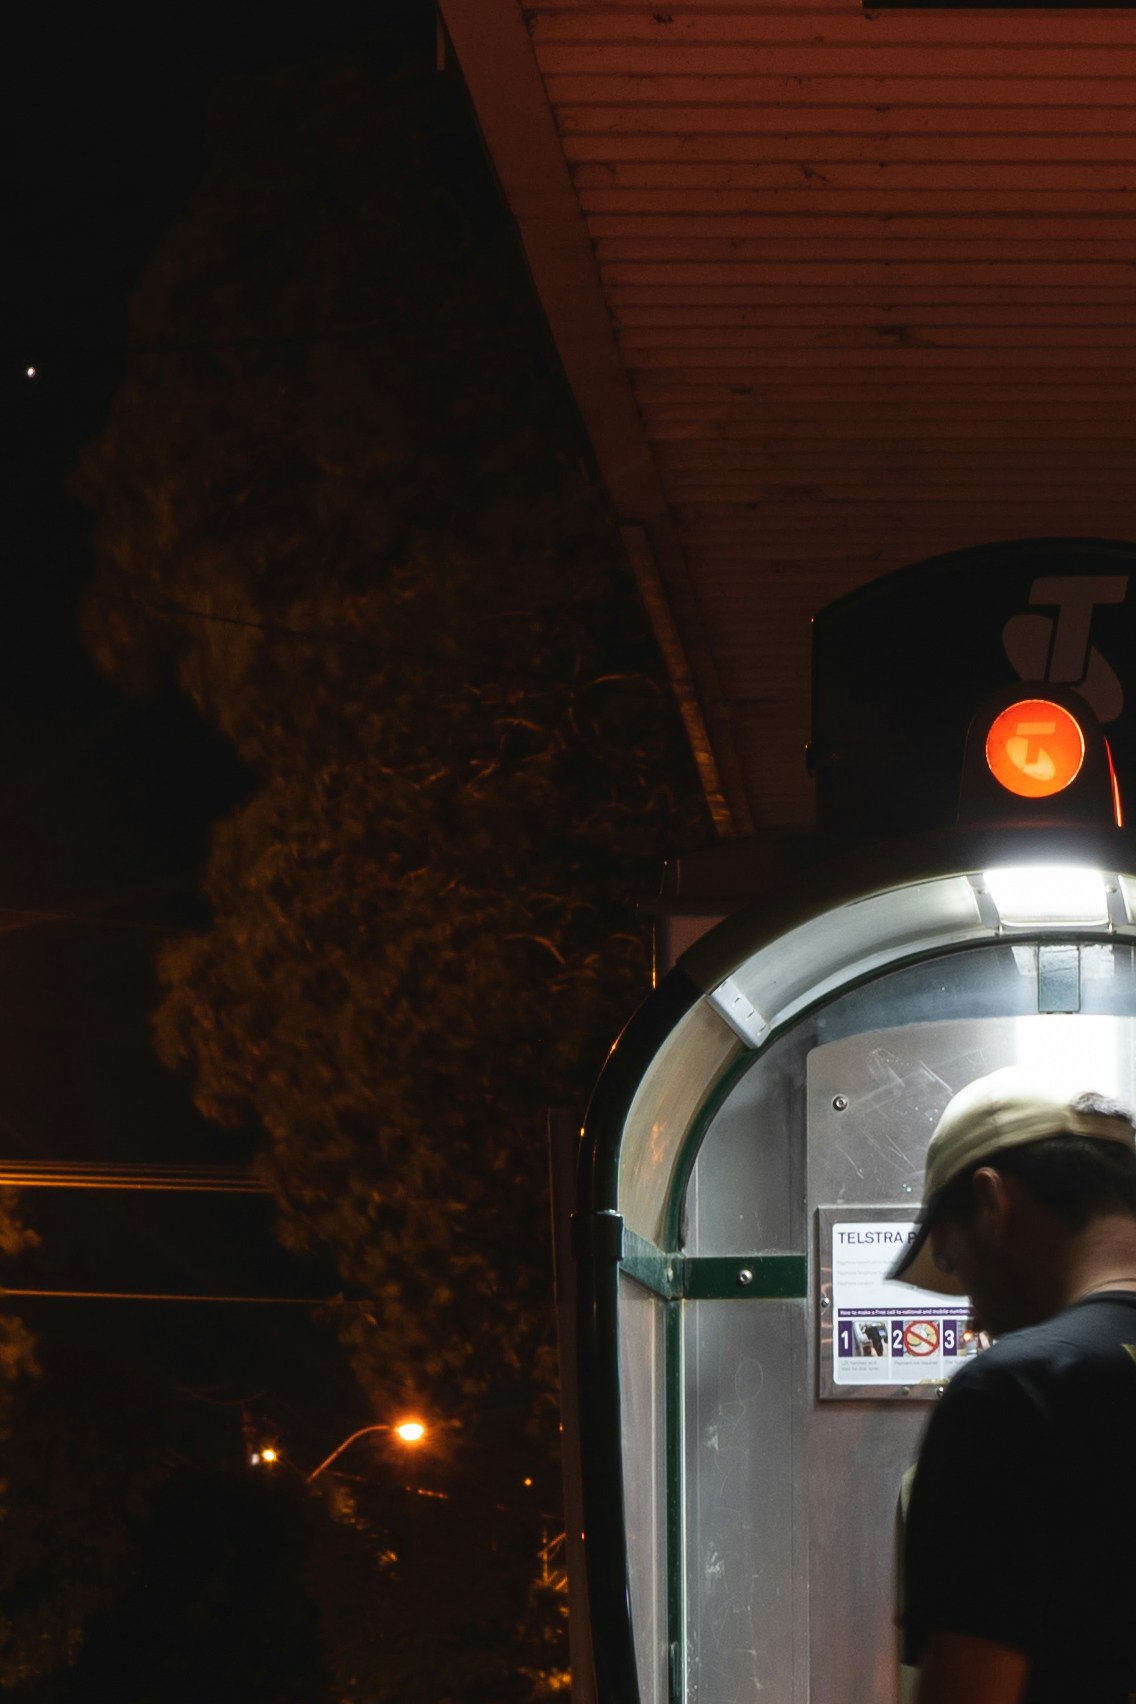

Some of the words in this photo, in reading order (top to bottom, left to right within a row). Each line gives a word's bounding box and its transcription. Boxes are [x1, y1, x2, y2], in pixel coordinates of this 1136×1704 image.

[837, 1231, 904, 1244] TELSTRA
[841, 1330, 849, 1350] 1
[892, 1330, 903, 1349] 2
[944, 1330, 955, 1349] 3
